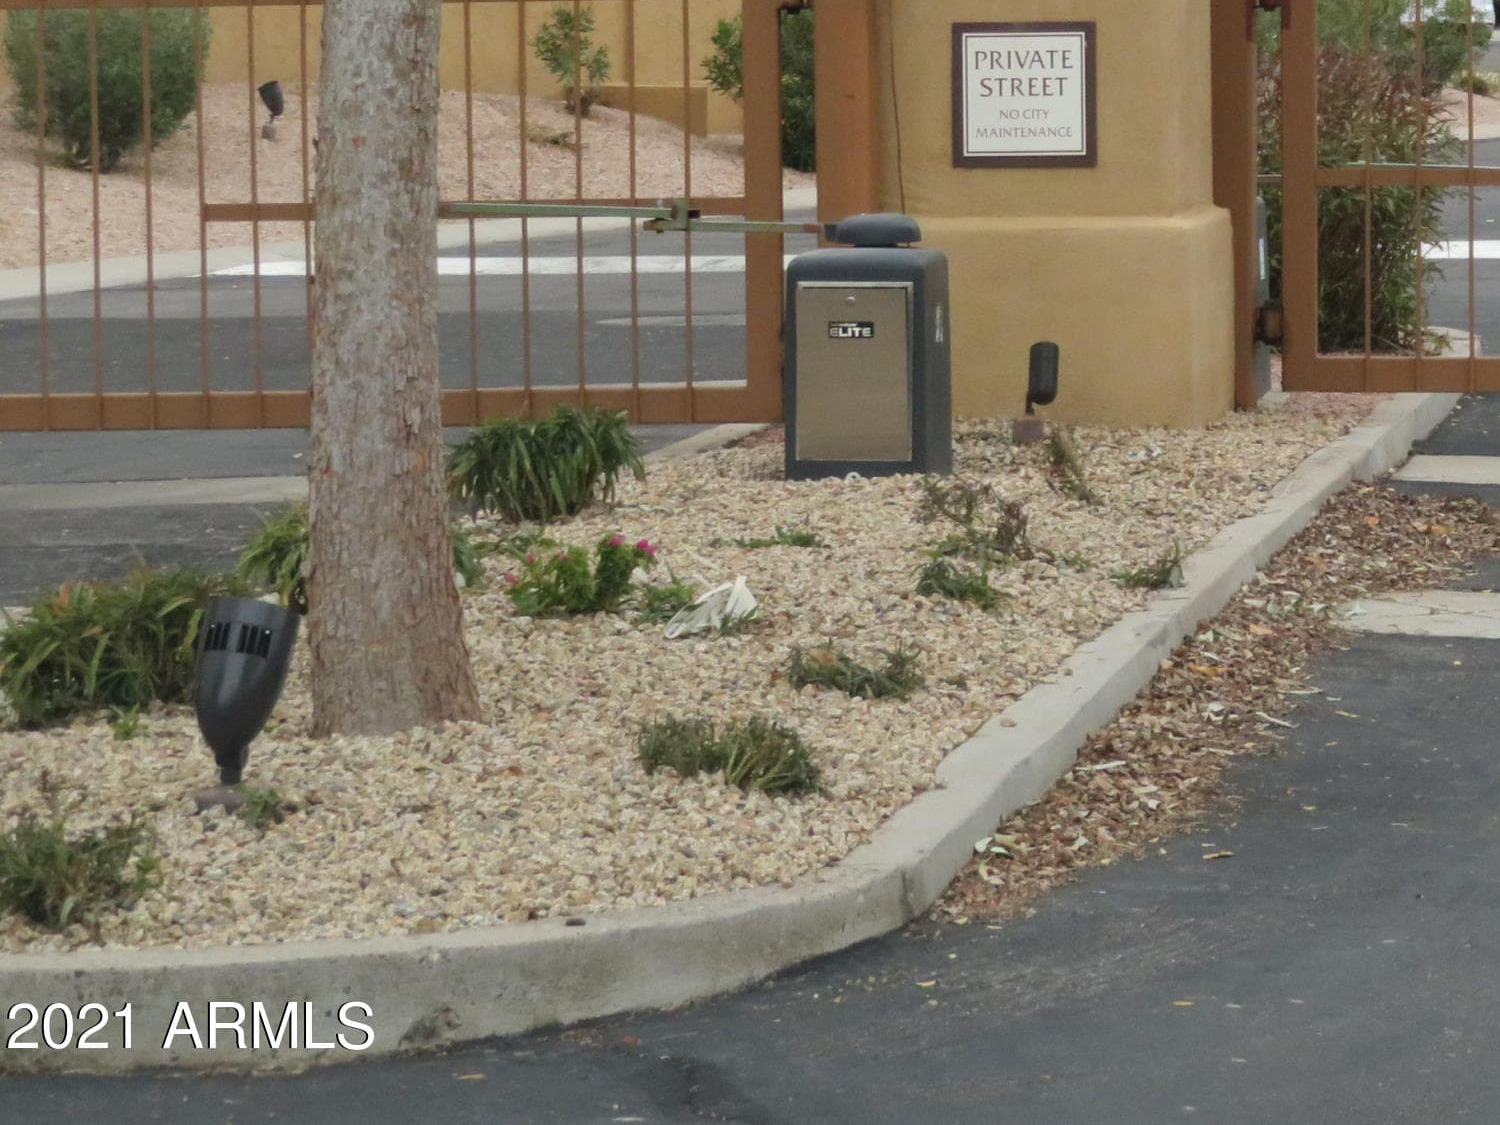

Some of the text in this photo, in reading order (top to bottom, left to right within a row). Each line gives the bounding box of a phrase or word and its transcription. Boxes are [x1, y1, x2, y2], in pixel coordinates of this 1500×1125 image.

[974, 50, 1074, 70] PRIVATE
[979, 77, 1069, 98] STREET
[1000, 108, 1050, 120] NO CITY
[976, 126, 1073, 139] MAINTENANCE
[830, 327, 872, 337] ELITE
